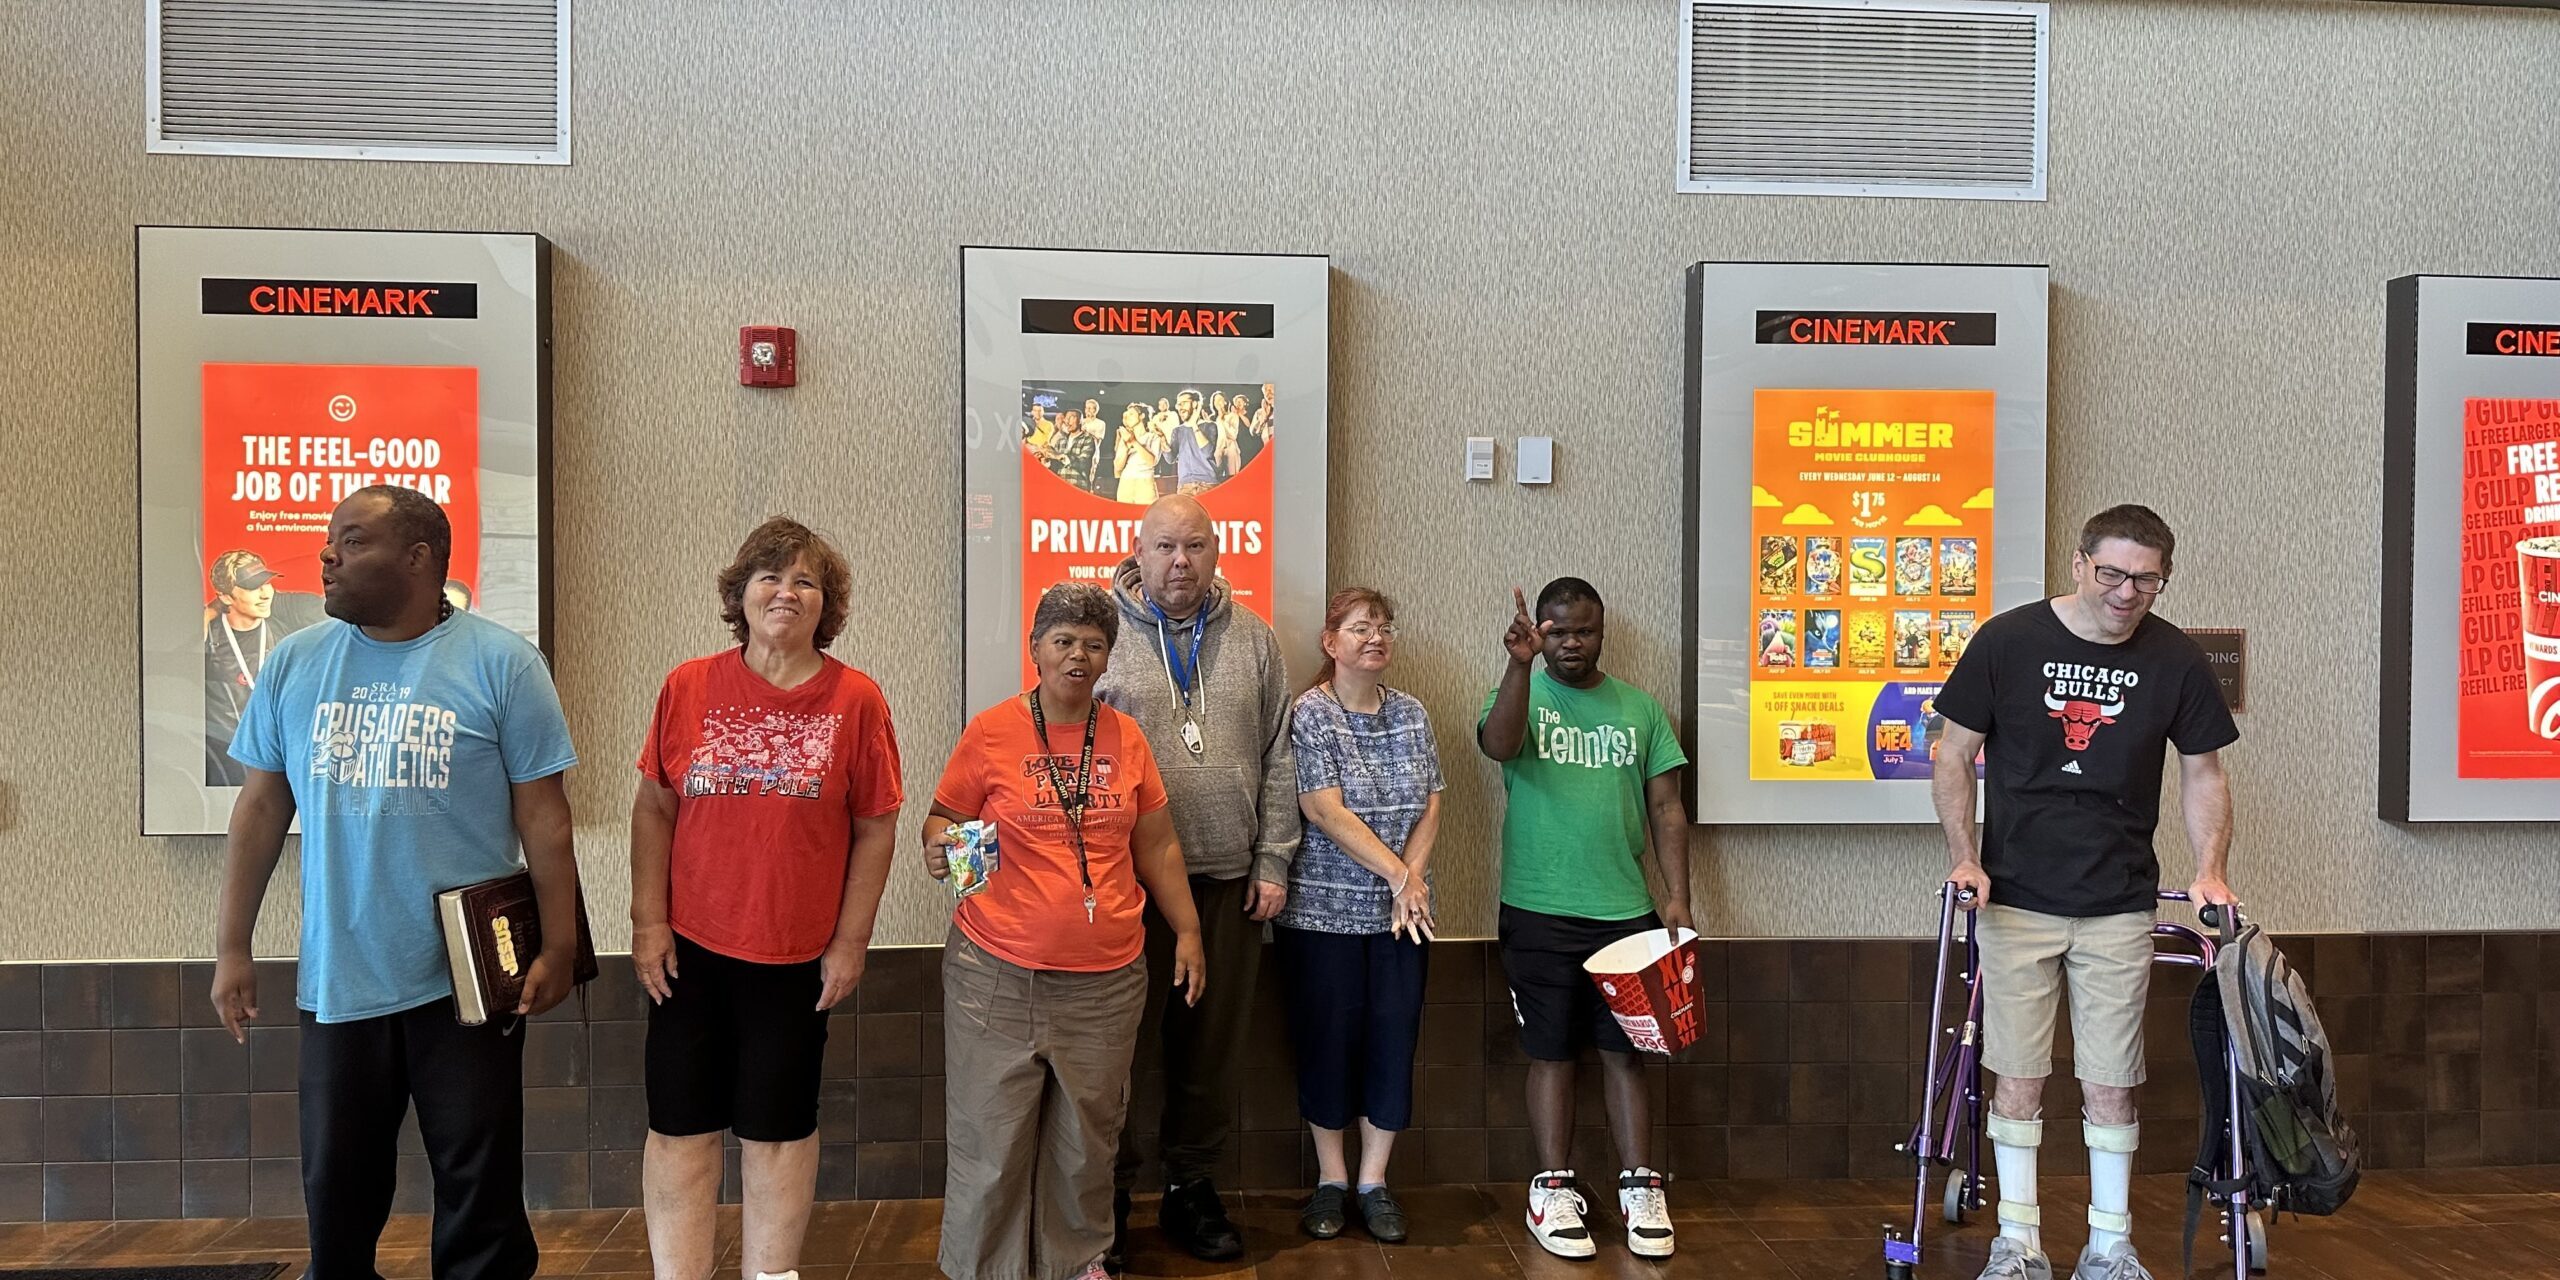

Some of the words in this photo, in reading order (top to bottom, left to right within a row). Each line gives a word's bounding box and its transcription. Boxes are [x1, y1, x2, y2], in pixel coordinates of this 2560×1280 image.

[2495, 329, 2560, 355] CINE
[1789, 417, 1954, 448] SUMMER
[2481, 427, 2510, 446] FREE
[2512, 422, 2551, 442] LARGE
[242, 436, 292, 466] THE
[299, 437, 441, 468] FEEL-GOOD
[1814, 453, 1853, 462] MOVIE
[1855, 453, 1926, 463] CLUBHOUSE
[2506, 441, 2559, 475] FREE
[2464, 449, 2502, 479] ULP
[232, 471, 281, 501] JOB
[289, 472, 322, 502] OF
[1799, 472, 1822, 481] EVERY
[1823, 472, 1866, 481] WEDNESDAY
[1868, 473, 1885, 482] JUNE
[1887, 473, 1895, 482] 12
[1903, 473, 1931, 482] AUGUST
[1932, 473, 1941, 482] 14
[2474, 477, 2531, 509] GULP
[2534, 472, 2560, 505] RE
[249, 511, 277, 521] Enjoy
[279, 511, 301, 519] free
[2483, 509, 2523, 528] REFILL
[2524, 504, 2560, 525] DRIN
[246, 524, 254, 532] a
[256, 523, 274, 532] fun
[275, 523, 328, 533] environme
[1031, 519, 1140, 554] PRIVAT
[1069, 566, 1096, 579] YOUR
[2491, 561, 2520, 590] GU
[2462, 595, 2494, 614] EFILL
[2538, 591, 2560, 603] CIN
[2465, 612, 2520, 645] GULP
[2498, 644, 2526, 673] GU
[2043, 662, 2139, 688] CHICAGO
[2461, 676, 2500, 696] REFILL
[352, 687, 368, 699] 20
[368, 692, 396, 703] CLC
[371, 682, 397, 692] SRA
[399, 687, 411, 699] 19
[2054, 679, 2120, 702] BULLS
[1538, 707, 1560, 724] The
[1774, 702, 1789, 711] OFF
[1791, 702, 1817, 711] SNACK
[1819, 702, 1844, 711] DEALS
[313, 702, 456, 747] CRUSADERS
[352, 742, 451, 789] ATHLETICS
[1079, 745, 1093, 795] goarmy.com
[1883, 756, 1898, 764] July
[684, 774, 751, 797] NORTH
[759, 776, 822, 799] POLE
[1016, 815, 1059, 823] AMERICA
[1670, 1002, 1694, 1019] CINEMARK
